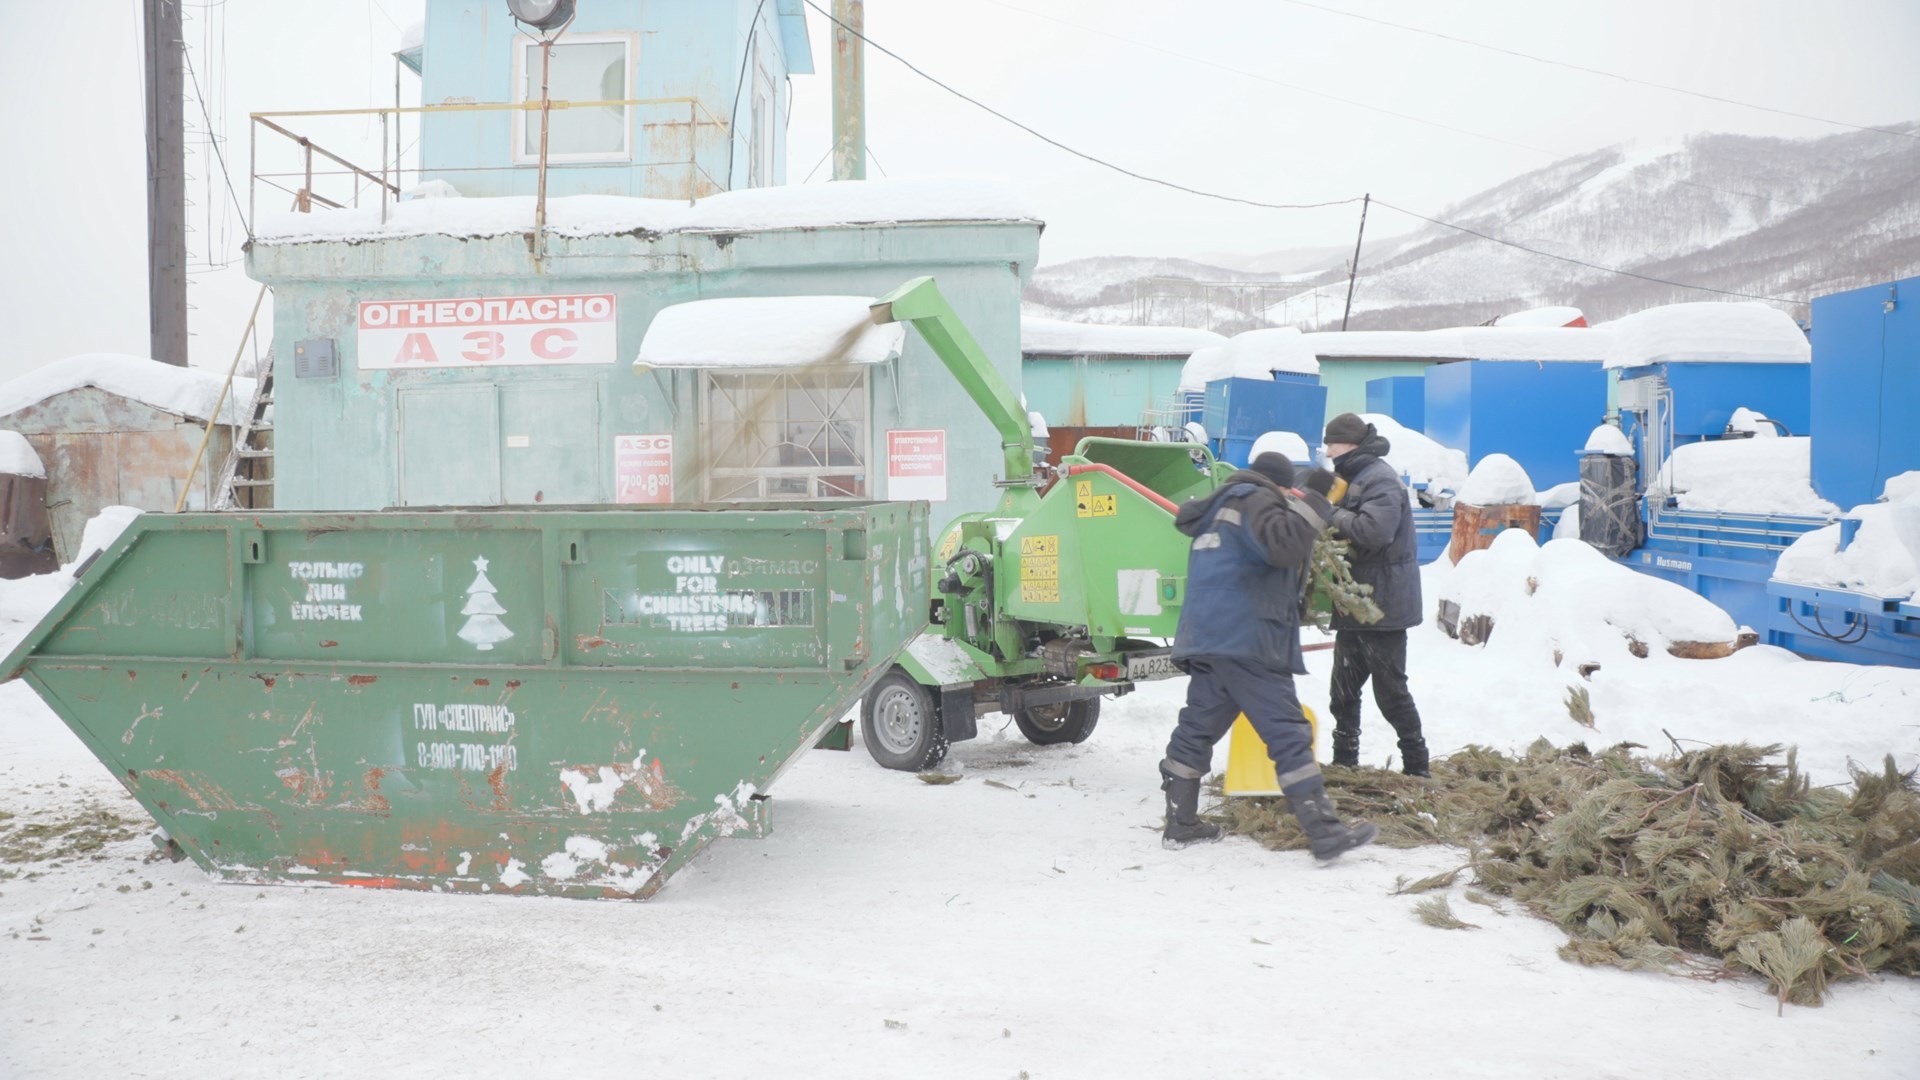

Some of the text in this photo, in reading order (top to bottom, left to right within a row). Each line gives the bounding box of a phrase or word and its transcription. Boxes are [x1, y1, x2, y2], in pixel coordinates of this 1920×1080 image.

[363, 297, 611, 326] ОГНЕОПАСНО
[619, 438, 671, 450] АЗС
[288, 561, 364, 579] ТОЛЬКО
[667, 555, 725, 574] ONLY
[1657, 556, 1692, 570] Husmann
[305, 583, 346, 602] ДЛЯ
[676, 575, 718, 593] FOR
[639, 594, 756, 615] CHRISTMAS
[666, 614, 728, 632] TREES
[413, 703, 516, 733] ГУП «СПЕЦТРАНС»
